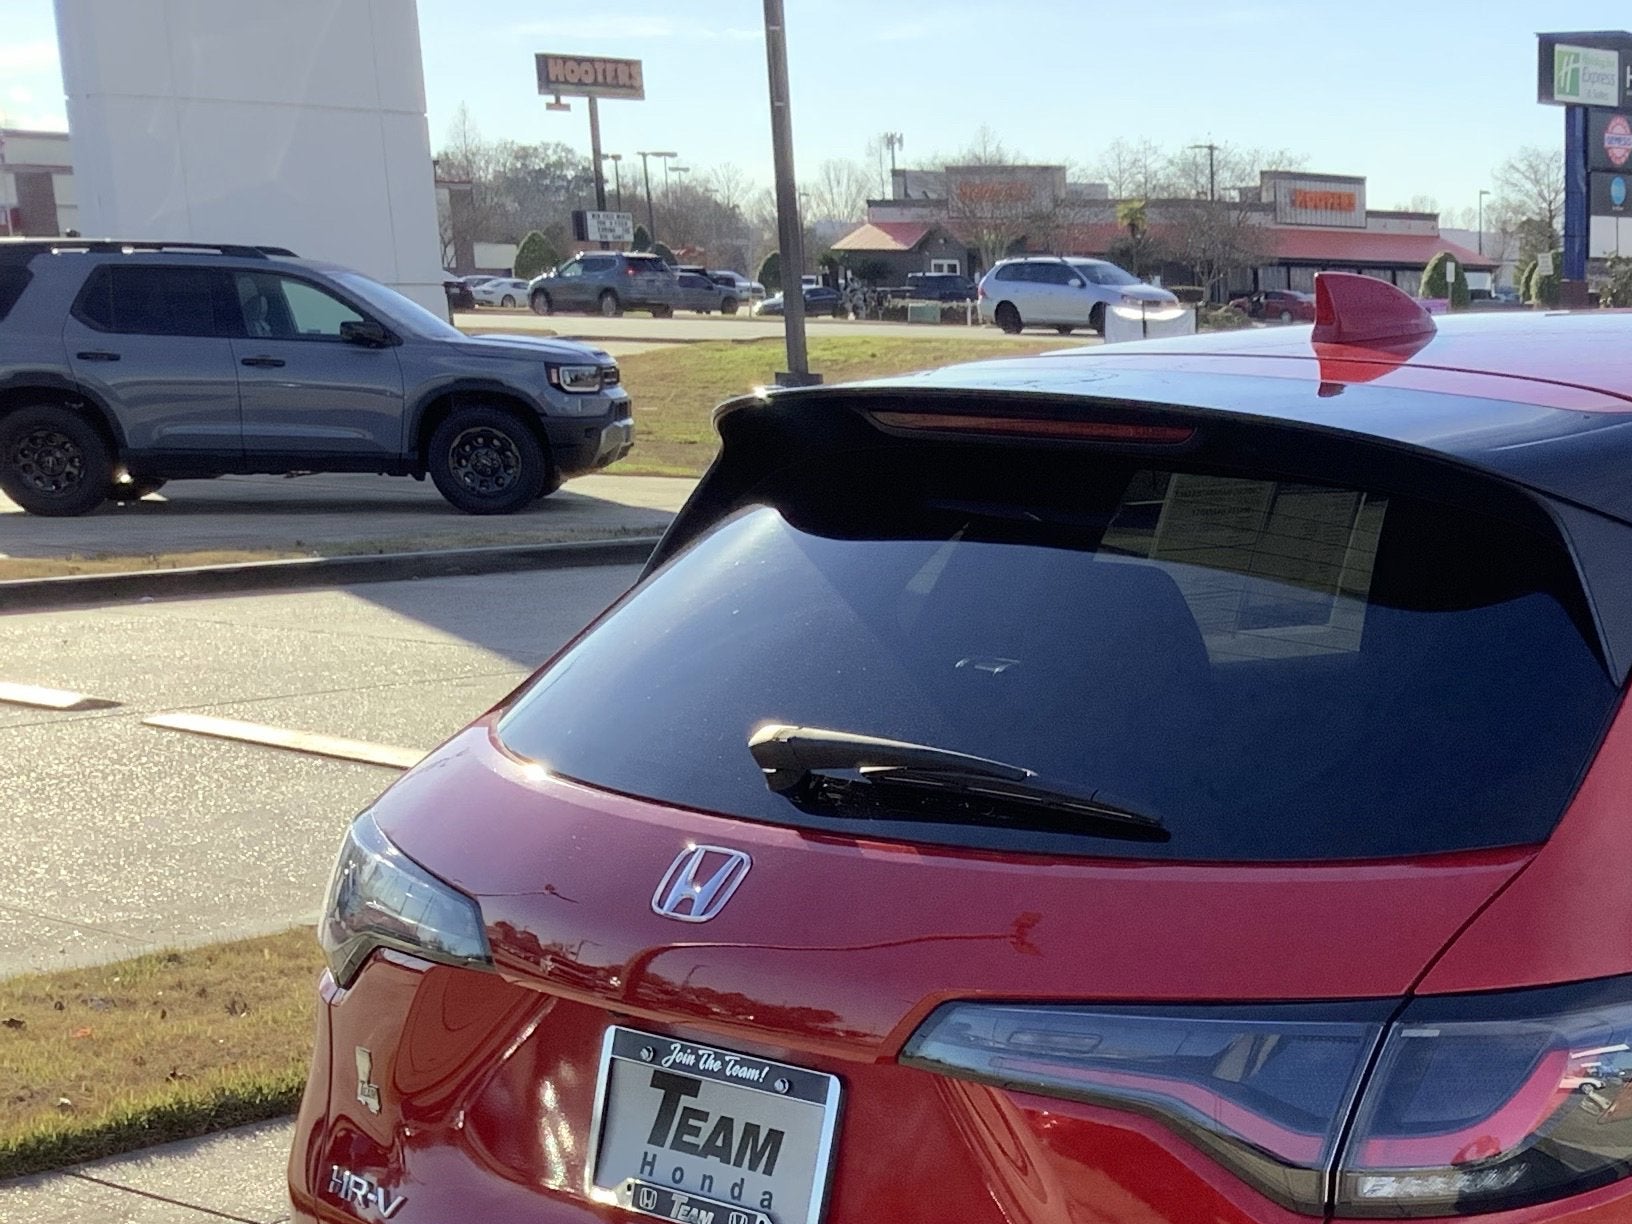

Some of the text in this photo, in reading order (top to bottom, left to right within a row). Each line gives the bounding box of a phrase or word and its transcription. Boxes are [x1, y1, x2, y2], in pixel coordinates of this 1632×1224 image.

[547, 58, 641, 88] HOOTERS
[662, 1042, 769, 1083] Join The Team!
[647, 1070, 785, 1177] TEAM
[328, 1165, 407, 1219] HR-V
[639, 1151, 774, 1211] Honda
